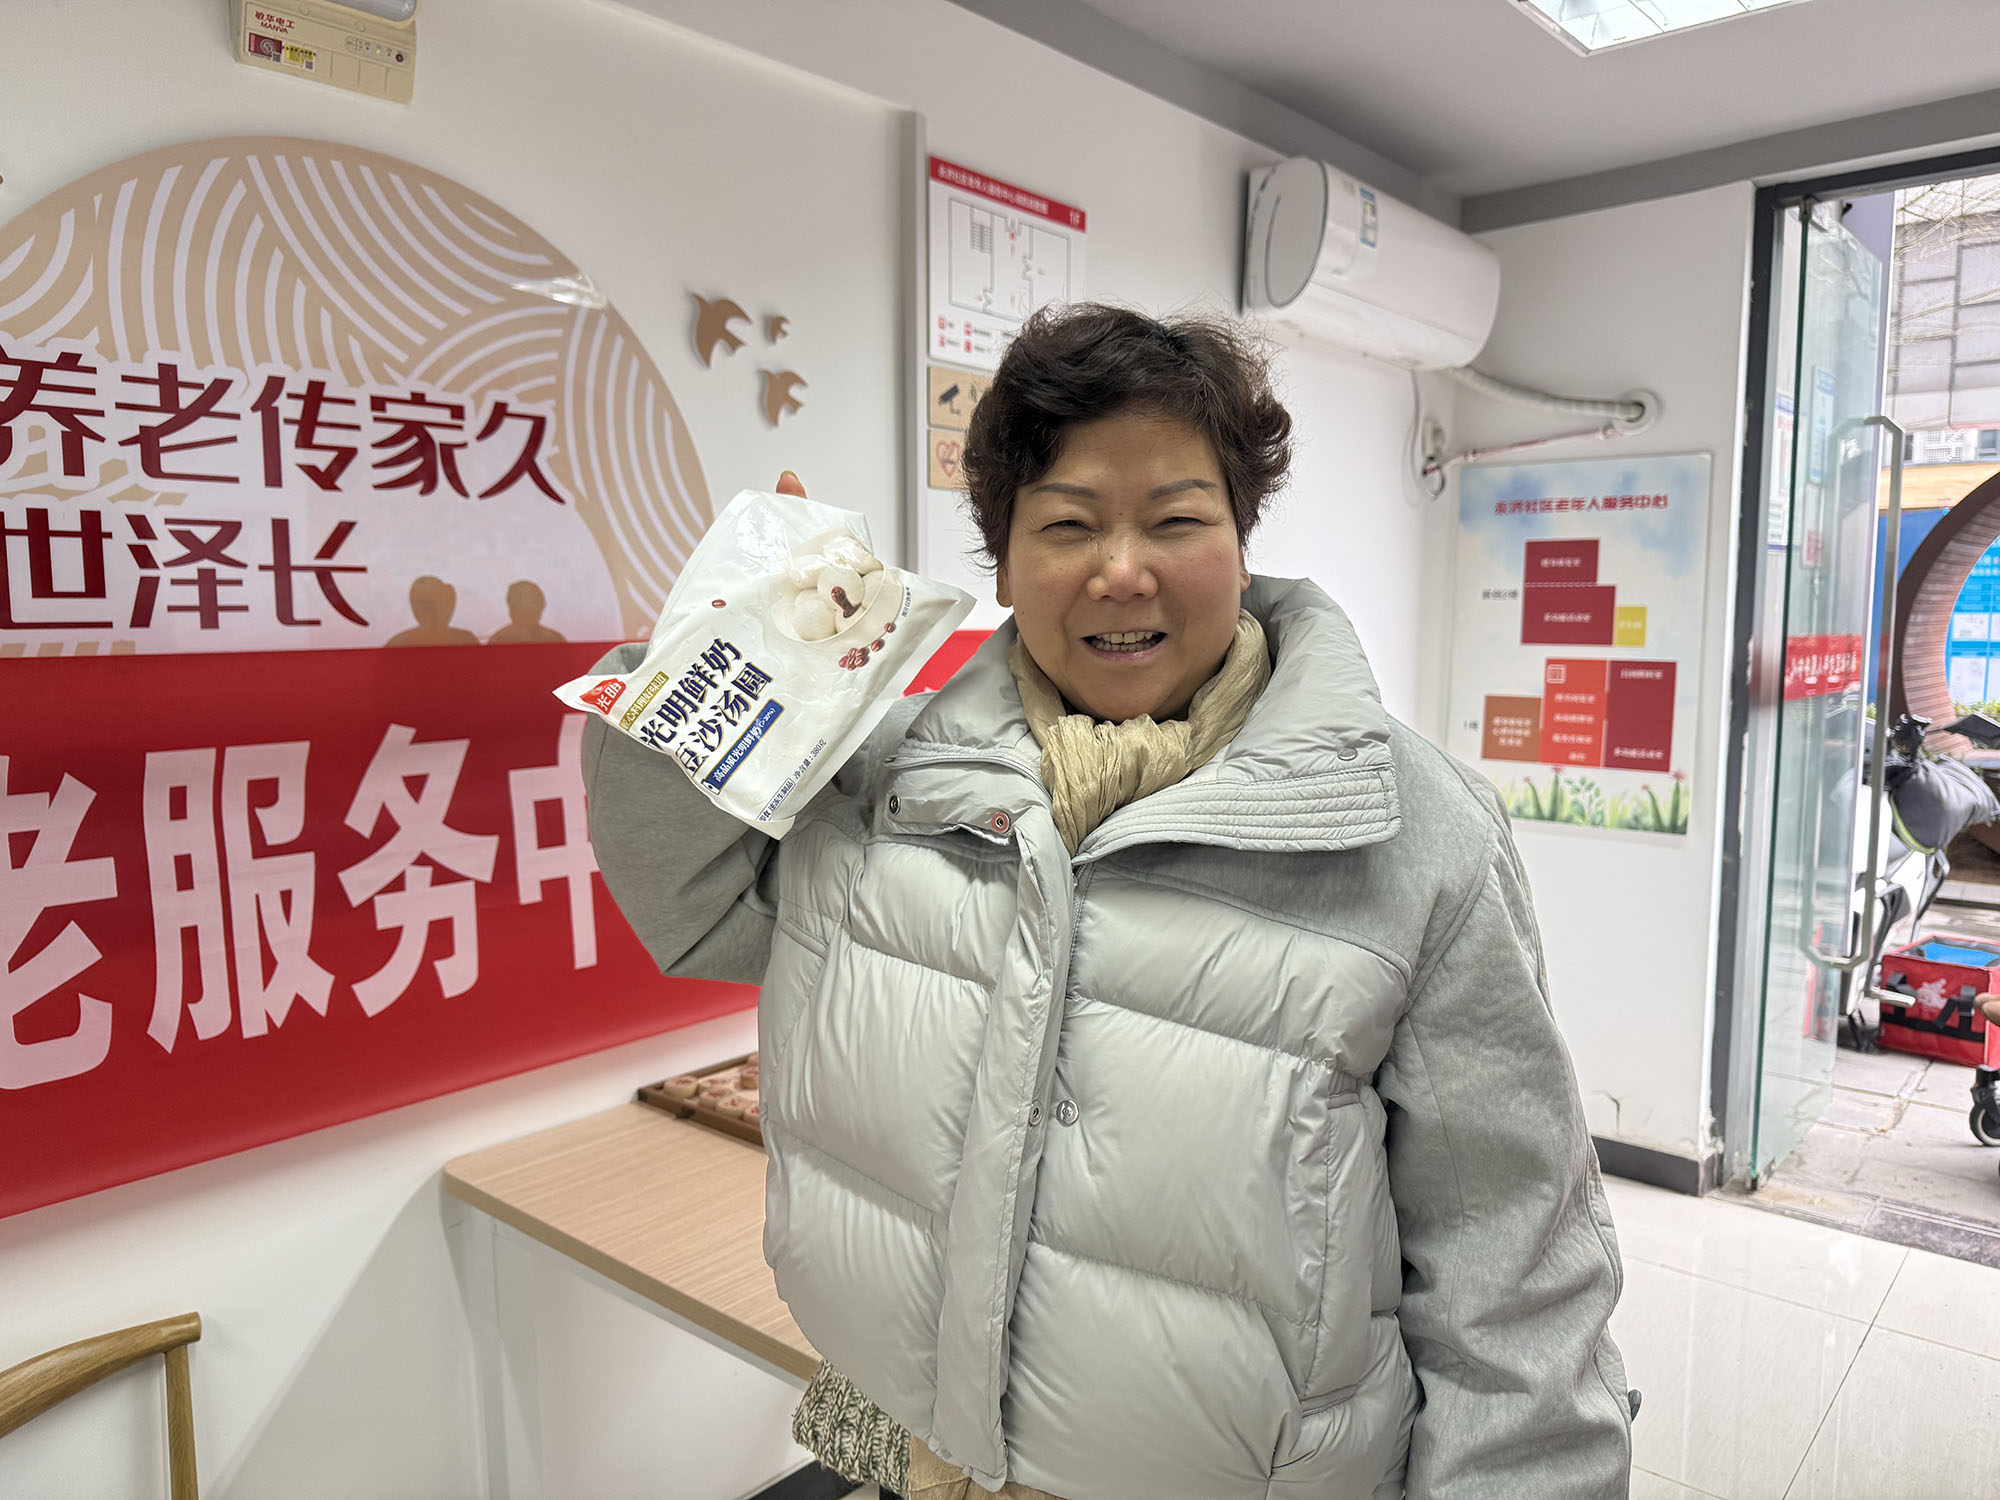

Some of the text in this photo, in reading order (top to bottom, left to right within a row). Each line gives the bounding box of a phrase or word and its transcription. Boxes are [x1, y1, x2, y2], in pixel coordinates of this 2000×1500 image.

[596, 681, 622, 711] 光明
[639, 638, 742, 752] 光明鲜奶
